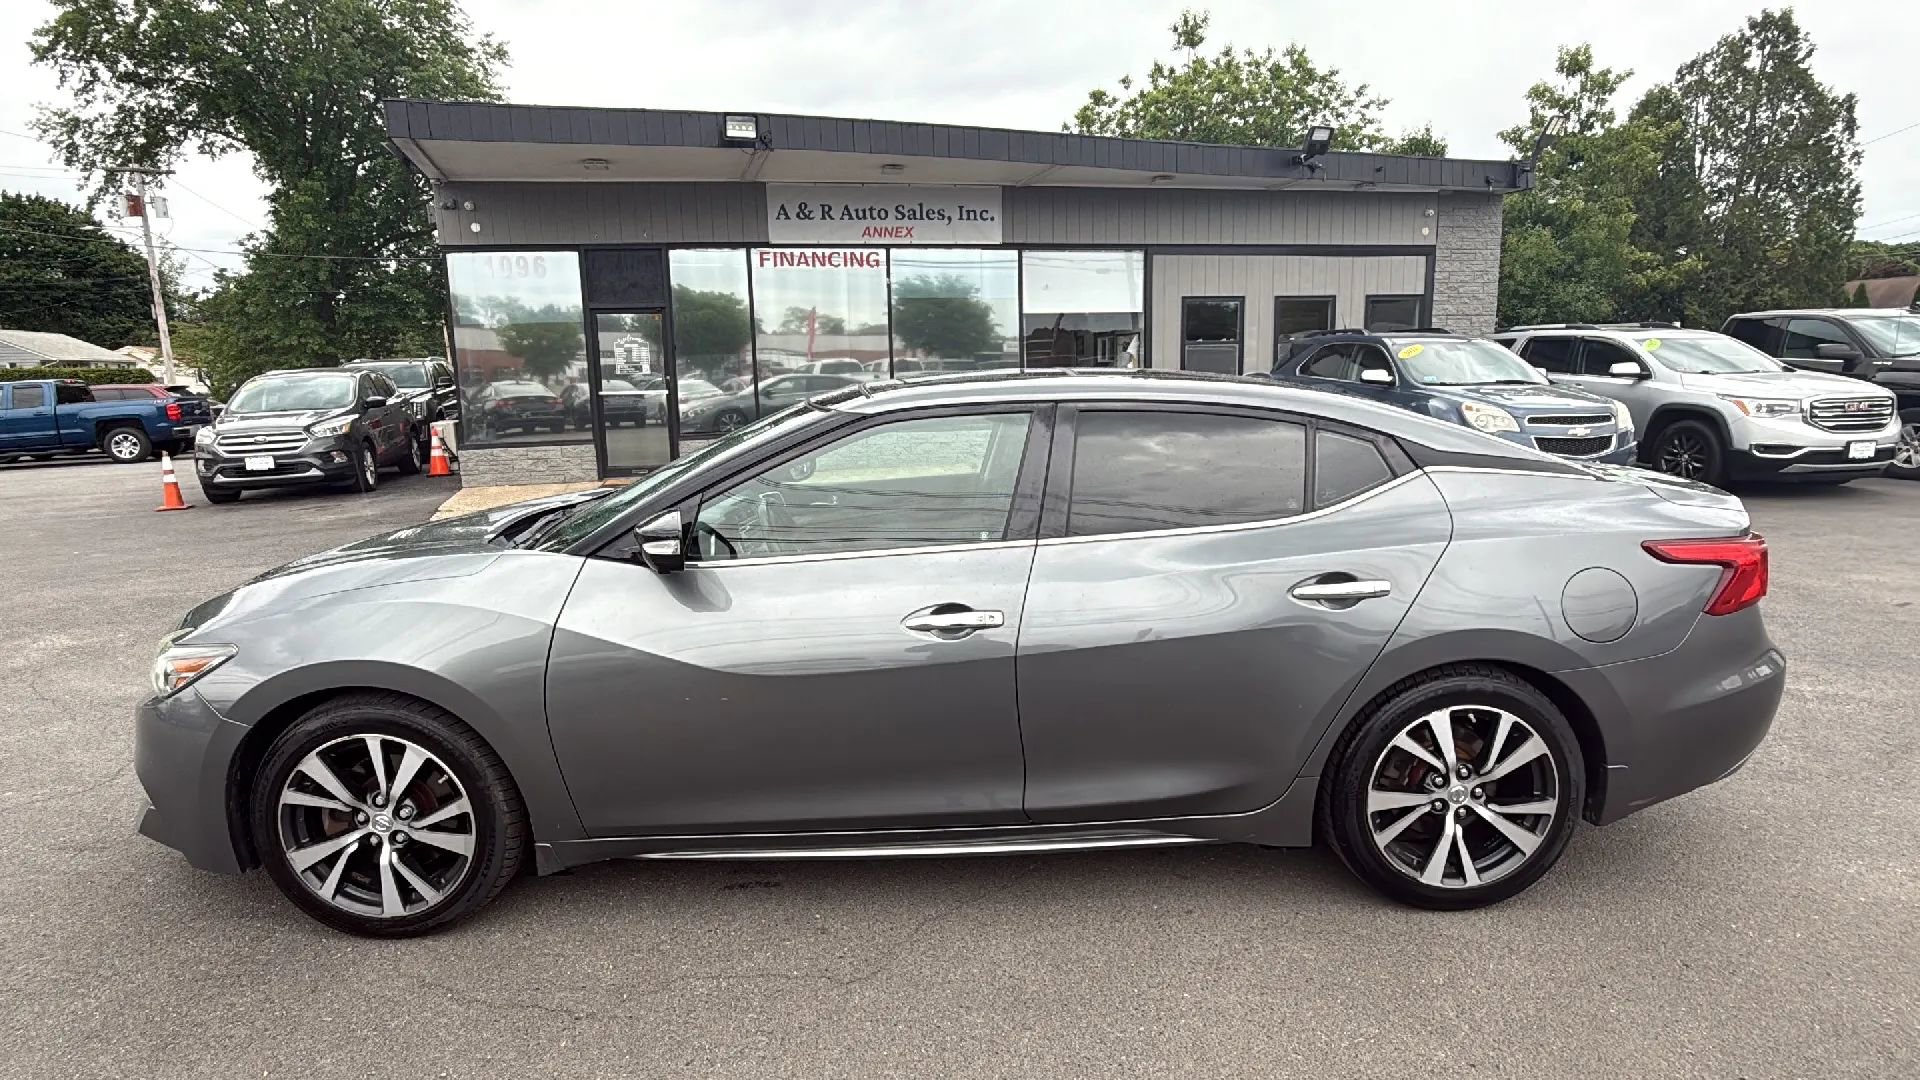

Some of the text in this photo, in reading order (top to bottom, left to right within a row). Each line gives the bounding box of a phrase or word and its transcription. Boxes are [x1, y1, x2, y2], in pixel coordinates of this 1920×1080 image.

[775, 202, 995, 225] A & R Auto Sales, Inc.
[861, 226, 914, 238] ANNEX
[759, 251, 880, 267] FINANCING
